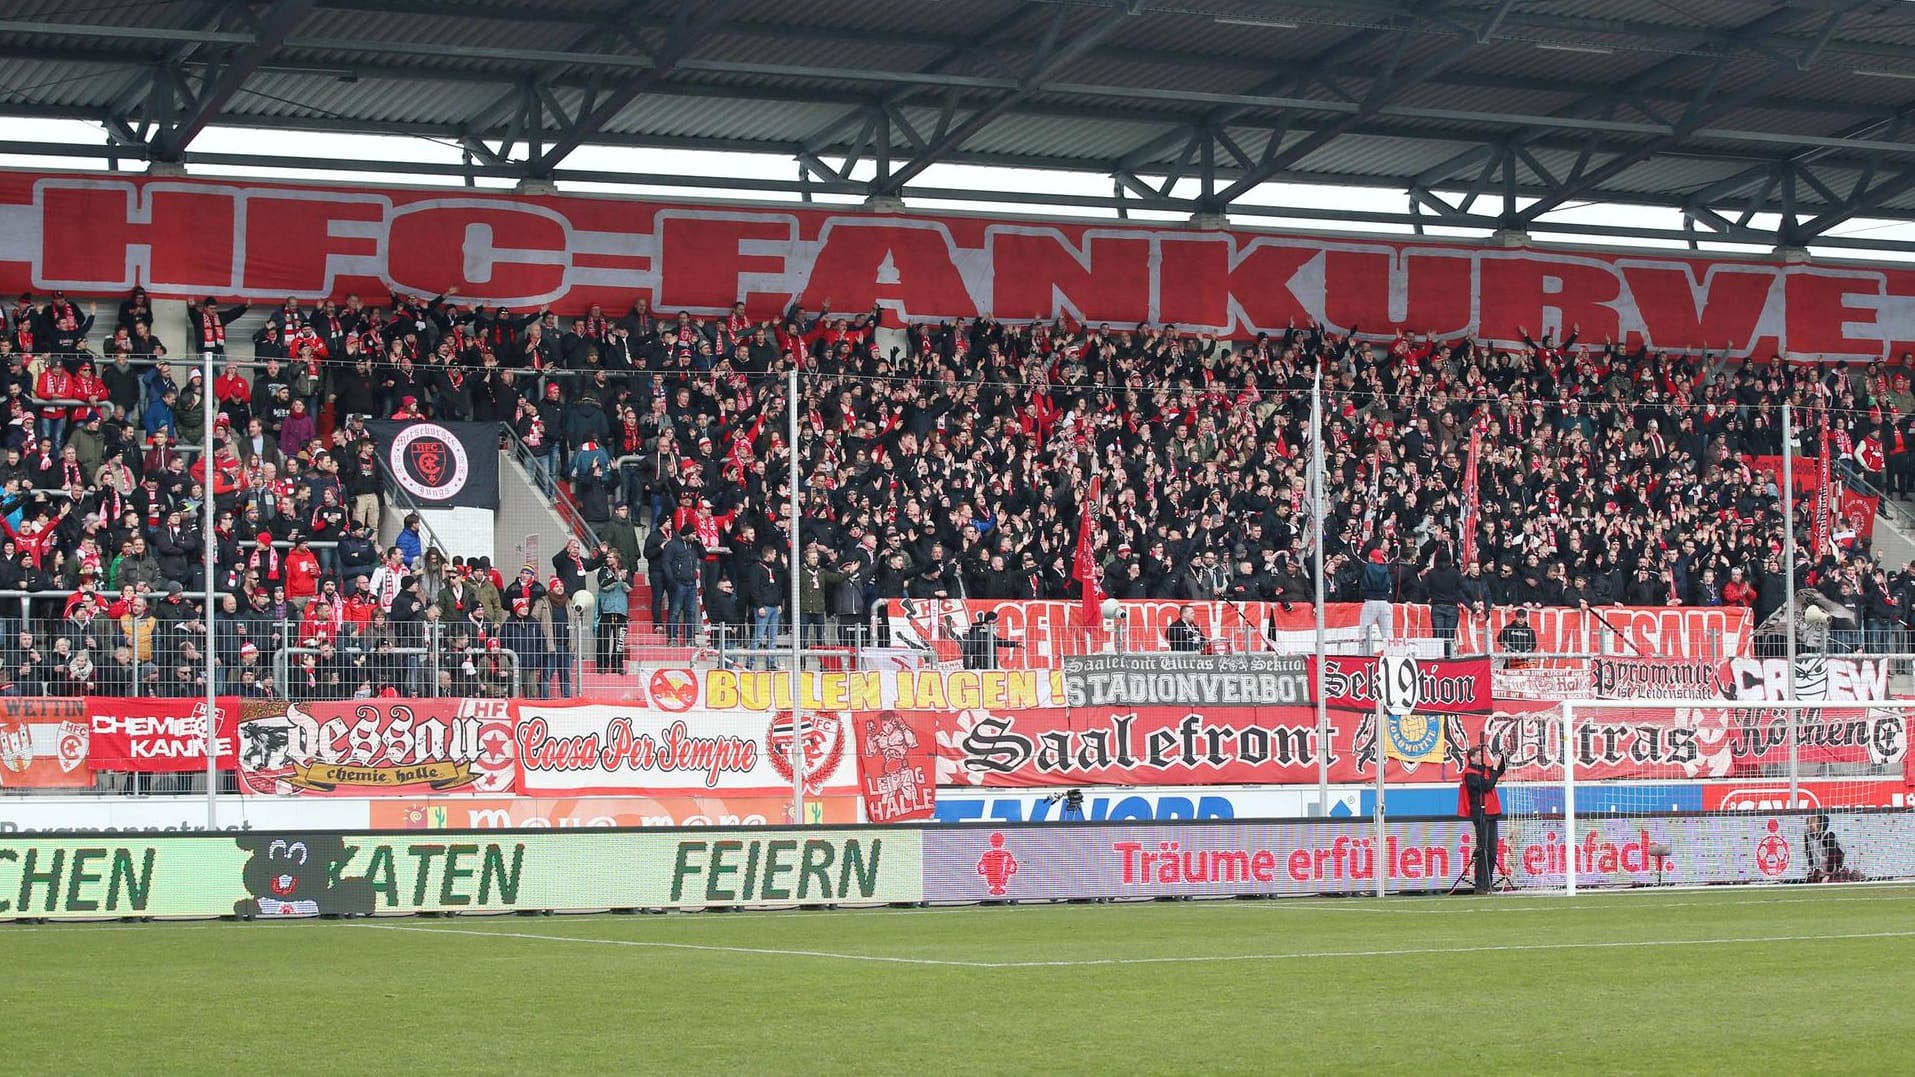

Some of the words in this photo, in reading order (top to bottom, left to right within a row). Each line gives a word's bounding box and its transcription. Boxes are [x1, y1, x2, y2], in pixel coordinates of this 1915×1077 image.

[704, 669, 882, 711] BULLEN
[895, 670, 1038, 711] JAGEN
[1066, 672, 1310, 707] STADIONVERBOT
[4, 700, 84, 716] WETTIN
[474, 702, 507, 717] HF
[65, 722, 87, 736] HFC
[963, 713, 1339, 774] Saalefront
[1486, 713, 1699, 768] Ultras
[131, 737, 233, 757] KANNE
[517, 716, 599, 771] Coesa
[601, 716, 656, 772] Per
[658, 720, 757, 788] Sempre
[327, 769, 386, 783] chemie
[396, 768, 438, 783] halle
[870, 788, 936, 823] HALLE
[671, 838, 882, 902] FEIERN
[1114, 841, 1276, 885] Träume
[1287, 835, 1450, 882] erfülen
[1460, 832, 1513, 877] it
